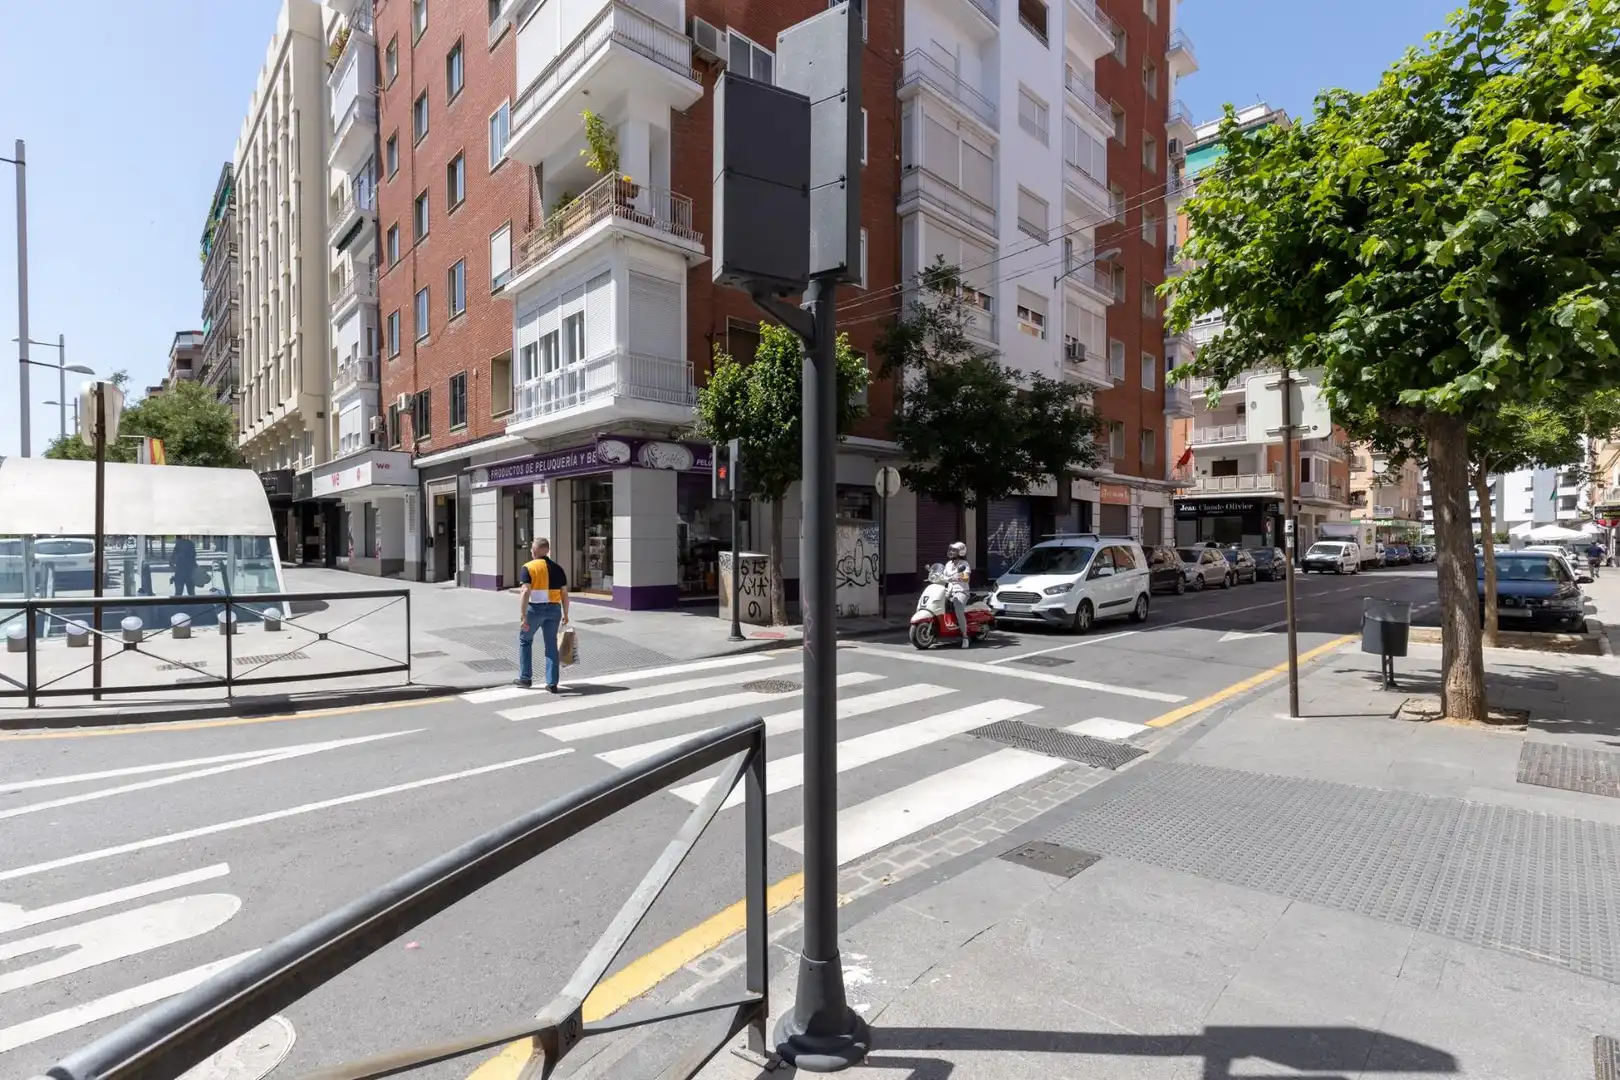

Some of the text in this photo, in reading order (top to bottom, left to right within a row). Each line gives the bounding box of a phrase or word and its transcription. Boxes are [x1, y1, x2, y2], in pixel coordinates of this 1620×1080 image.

[491, 465, 524, 479] PRODUCTOS
[525, 463, 534, 473] DE
[535, 453, 578, 472] PELUQUERÍA
[580, 453, 585, 465] Y
[1226, 502, 1254, 510] Olivier
